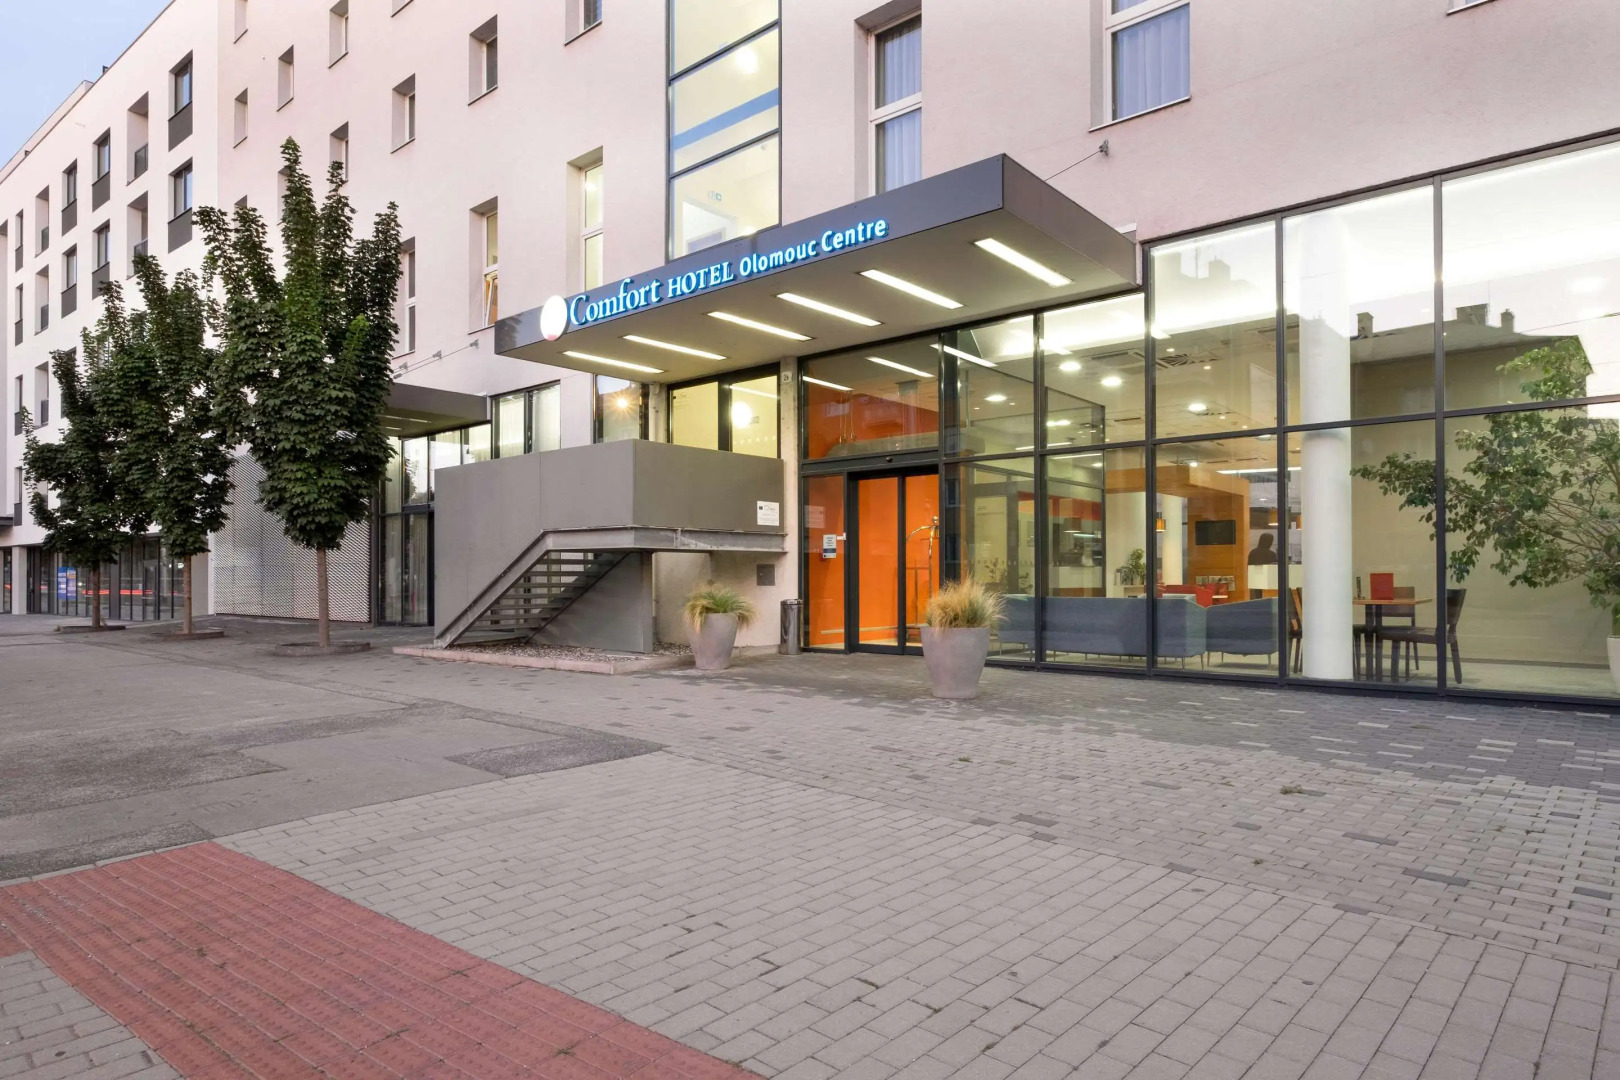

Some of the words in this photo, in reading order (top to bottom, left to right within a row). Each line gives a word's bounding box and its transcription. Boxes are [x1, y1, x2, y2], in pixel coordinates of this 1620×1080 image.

[570, 278, 662, 326] Comfort
[667, 261, 735, 298] HOTEL
[739, 240, 818, 277] Olomouc
[821, 219, 888, 252] Centre
